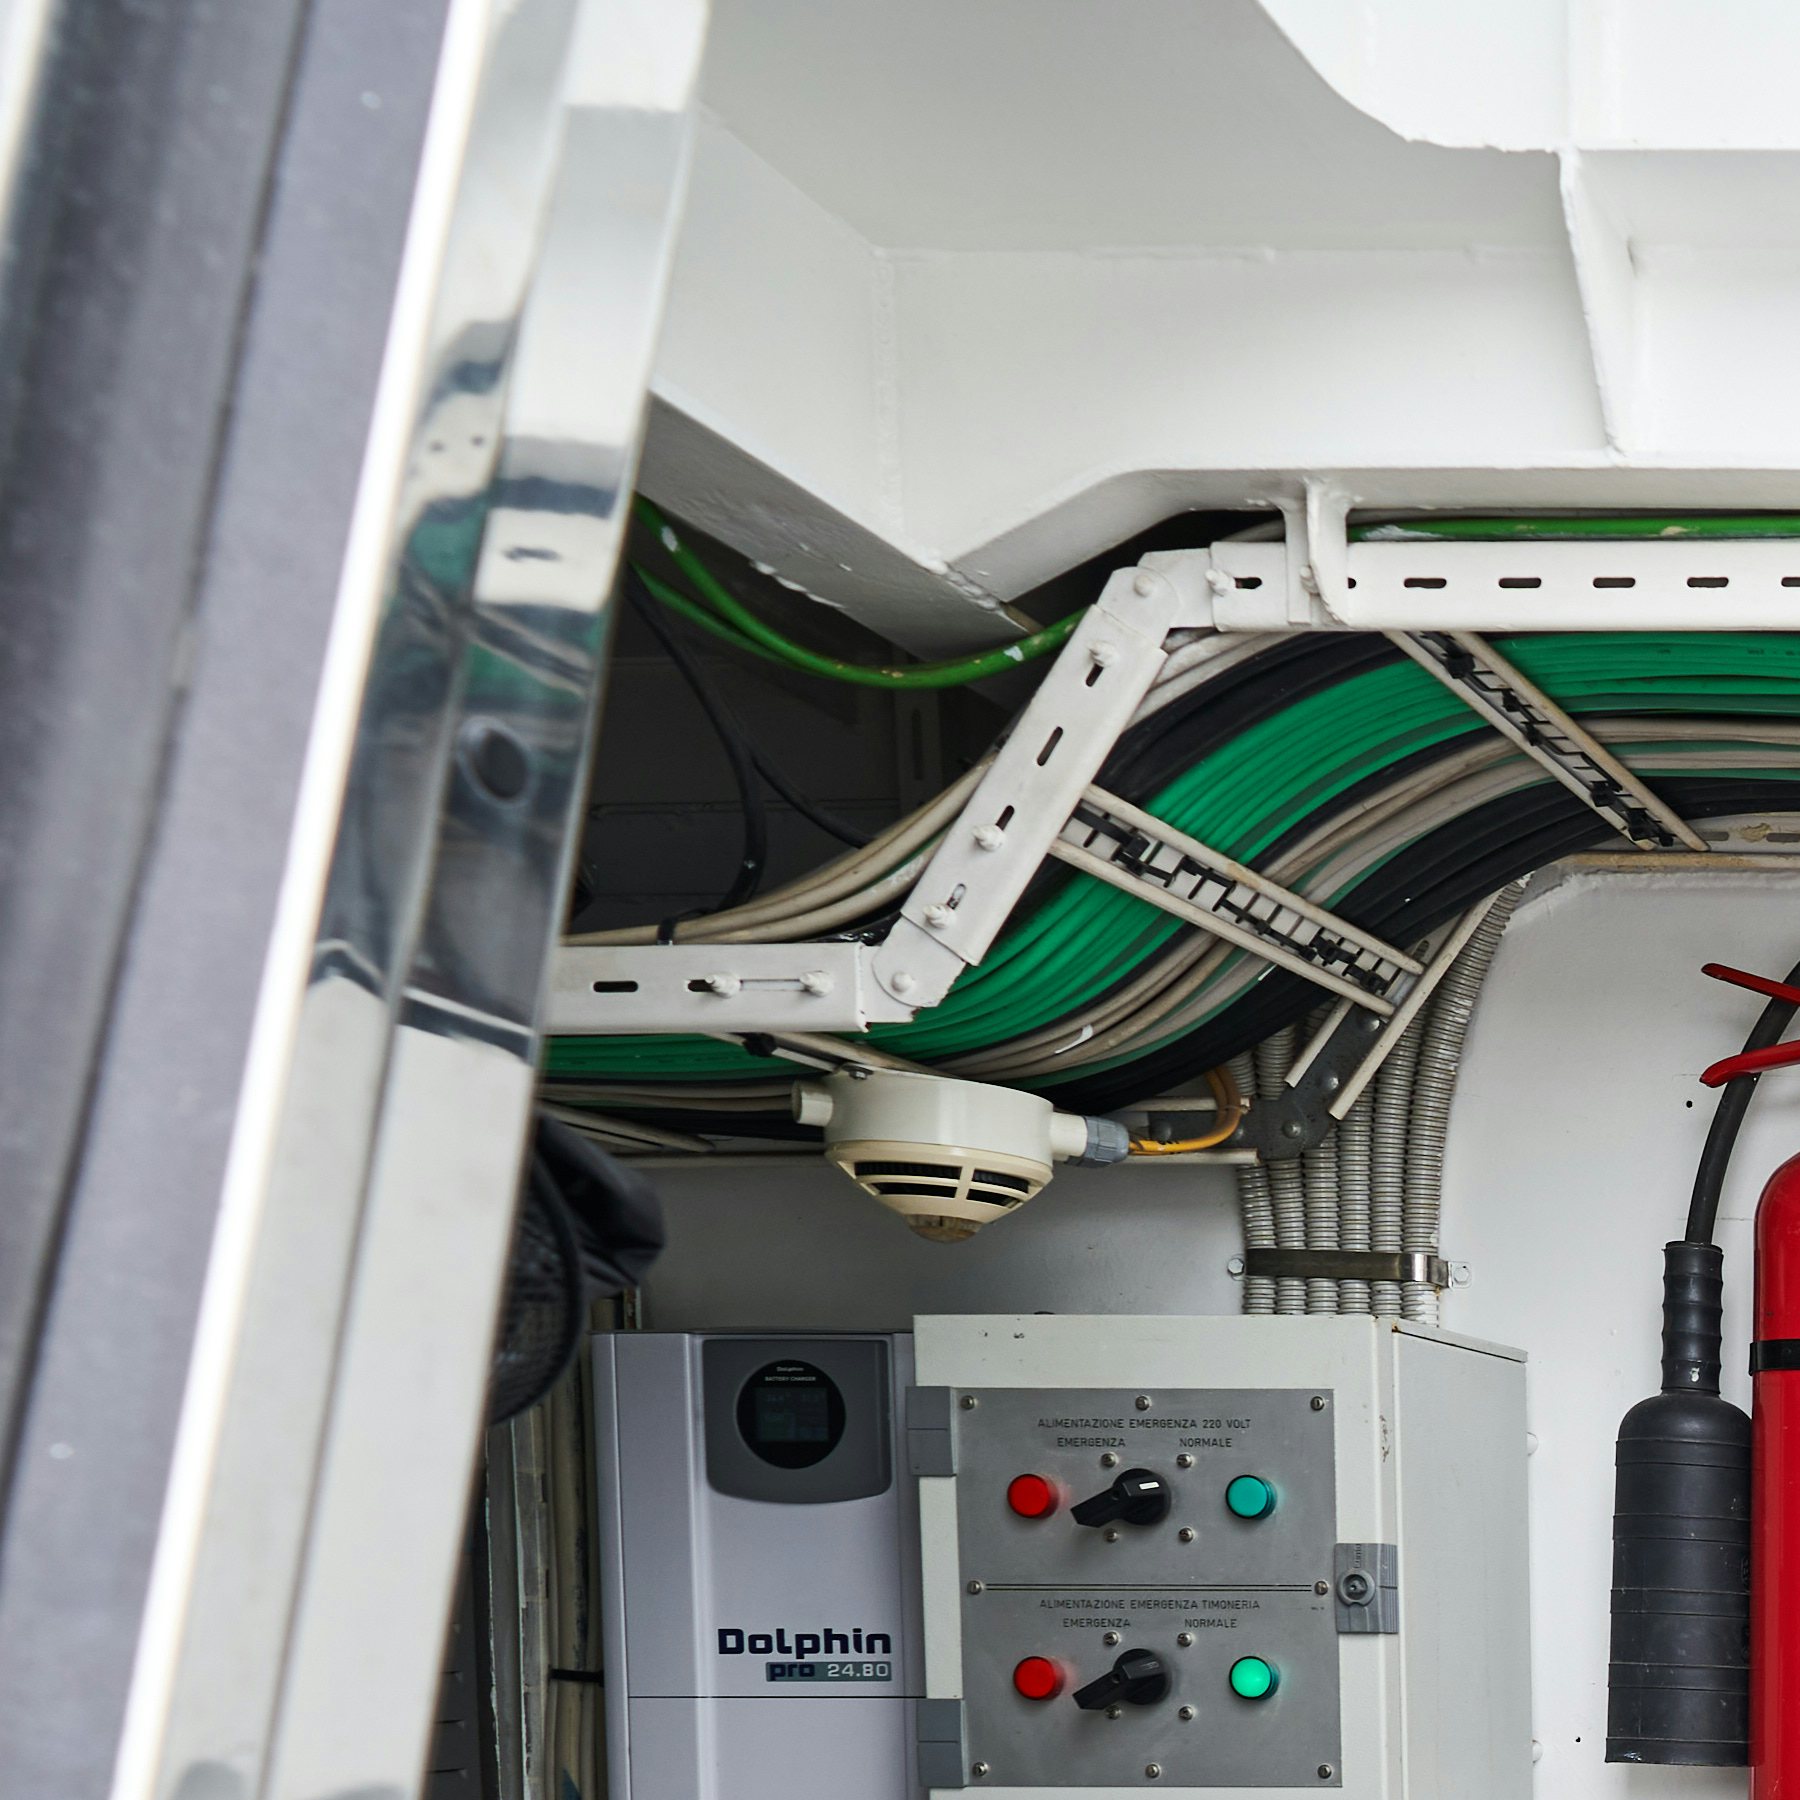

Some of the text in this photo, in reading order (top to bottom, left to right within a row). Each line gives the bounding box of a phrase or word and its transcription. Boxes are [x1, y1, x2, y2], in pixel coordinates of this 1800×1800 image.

[1037, 1418, 1252, 1430] ALIMENTAZIONE EMERGENZA 220 VOLT
[1056, 1436, 1127, 1448] EMERGENZA
[1179, 1437, 1233, 1448] NORMALE
[1039, 1599, 1261, 1610] ALIMENTAZIONE EMERGENZA TIMONERIA
[1062, 1617, 1132, 1629] EMERGENZA
[1184, 1618, 1238, 1629] NORMALE
[718, 1628, 892, 1660] Dolphin
[769, 1663, 891, 1682] pro 24.80
